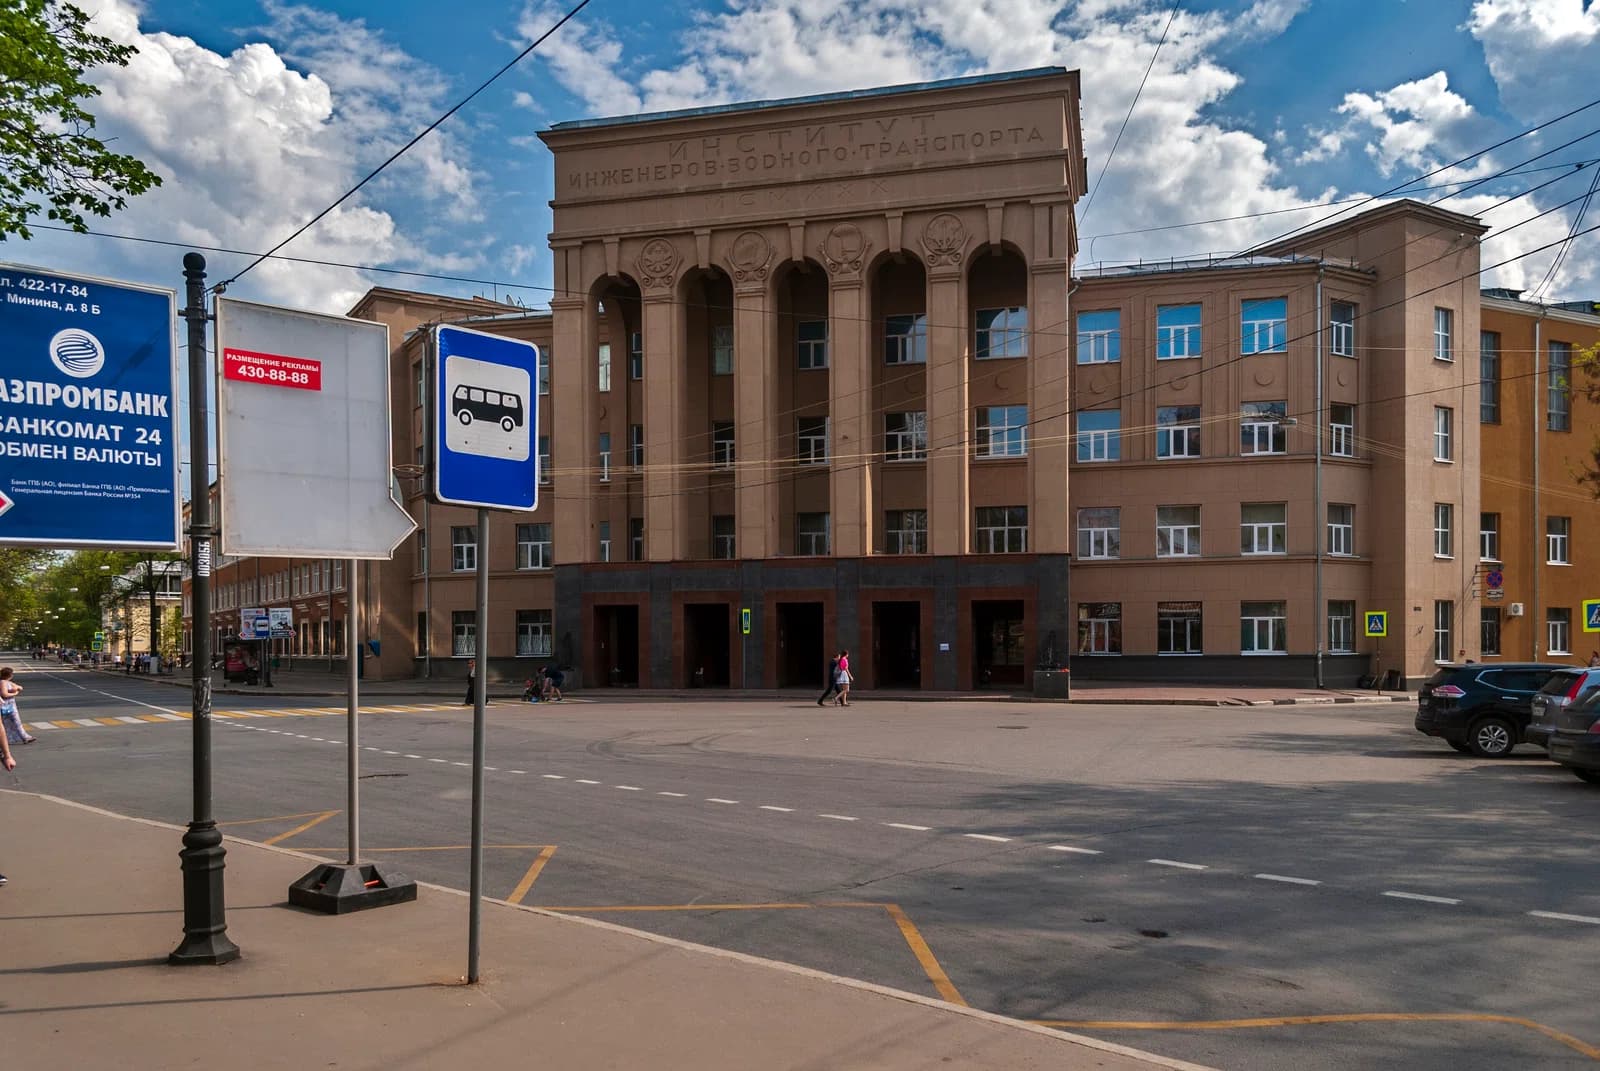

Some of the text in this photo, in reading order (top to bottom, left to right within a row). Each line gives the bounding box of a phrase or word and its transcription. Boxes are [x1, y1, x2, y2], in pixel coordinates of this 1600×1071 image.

[668, 113, 936, 163] ИНСТИТУТ
[569, 127, 1045, 190] ИНЖЕНЕРОВ ВОДНОГО ТРАНСПОРТА
[19, 278, 88, 298] 422-17-84
[7, 293, 101, 315] Минина, д. 8 Б
[226, 353, 319, 372] РАЗМЕЩЕНИЕ РЕКЛАМЫ
[237, 364, 309, 384] 430-88-88
[135, 427, 162, 446] 24
[73, 446, 162, 467] ВАЛЮТЫ
[198, 541, 210, 577] 003056
